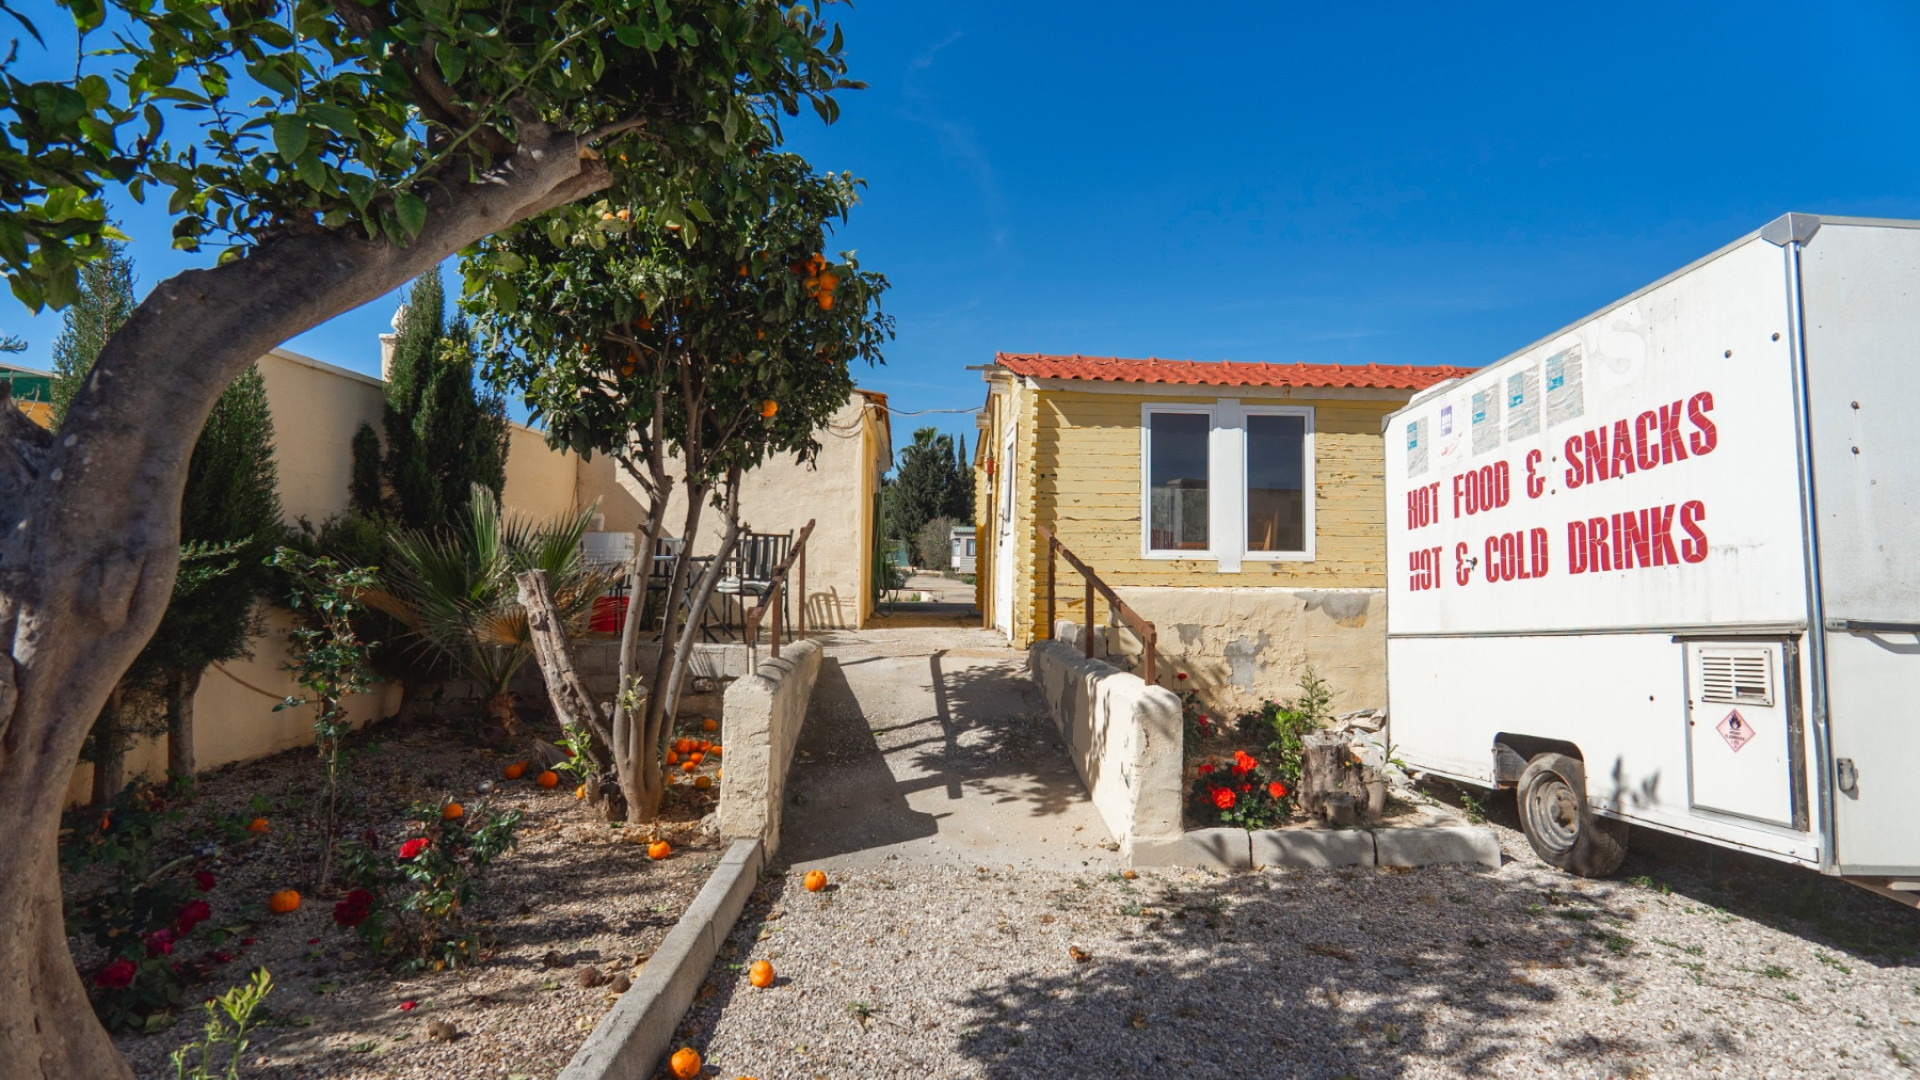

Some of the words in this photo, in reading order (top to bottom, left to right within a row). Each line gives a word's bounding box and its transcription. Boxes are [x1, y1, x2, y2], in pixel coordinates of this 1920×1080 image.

[1407, 481, 1440, 530] HOT
[1453, 460, 1510, 518] FOOD
[1526, 449, 1545, 499] &
[1565, 391, 1718, 489] SNACKS
[1409, 546, 1442, 592] HOT
[1455, 541, 1471, 587] &
[1484, 527, 1549, 583] COLD
[1567, 500, 1708, 575] DRINKS
